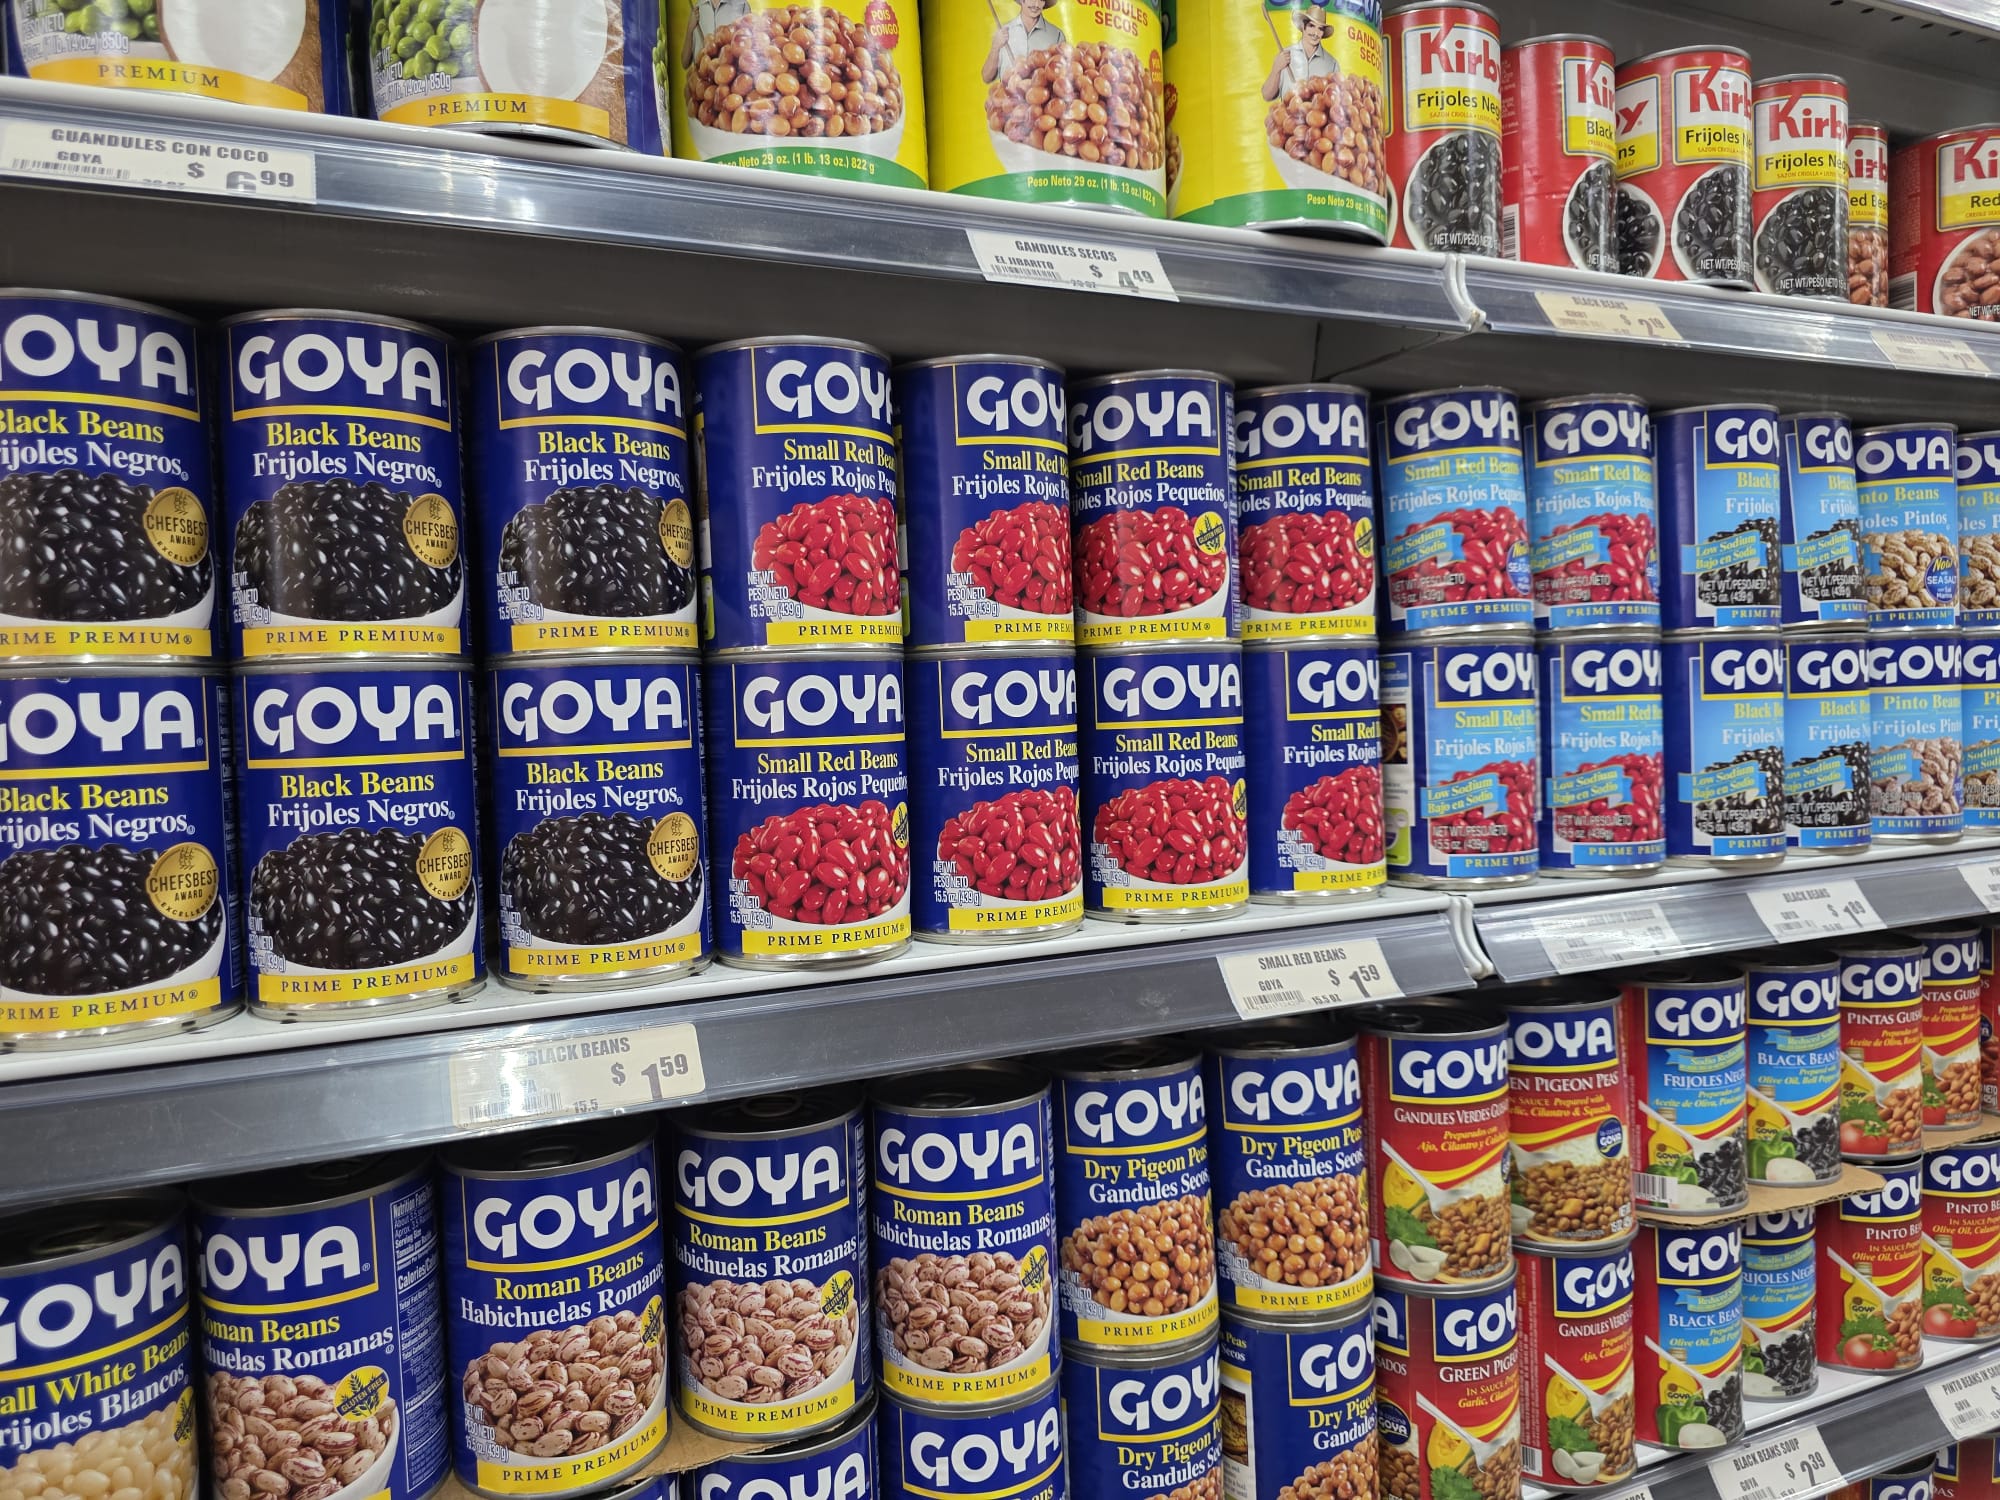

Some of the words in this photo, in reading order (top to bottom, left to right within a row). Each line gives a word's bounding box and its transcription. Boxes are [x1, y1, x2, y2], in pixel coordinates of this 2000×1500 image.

[871, 9, 891, 22] POIS
[1095, 11, 1138, 36] SECOS
[870, 23, 898, 36] CONGO
[98, 64, 220, 89] PREMIUM
[428, 100, 528, 117] PREMIUM
[1417, 90, 1477, 110] Frijoles
[50, 129, 167, 153] GUANDULES
[172, 142, 212, 157] CON
[217, 147, 270, 163] COCO
[1685, 128, 1739, 145] Frijoles
[57, 151, 102, 165] GOYA
[739, 155, 759, 169] Neto
[762, 153, 774, 166] 29
[776, 153, 790, 166] oz.
[792, 152, 801, 166] (1
[804, 152, 816, 166] lb.
[820, 154, 831, 166] 13
[833, 154, 849, 168] oz.)
[851, 159, 867, 171] 822
[869, 162, 875, 174] g
[1765, 155, 1824, 171] Frijoles
[187, 162, 205, 179] $
[1027, 176, 1048, 187] Peso
[1051, 175, 1071, 186] Neto
[1074, 176, 1084, 187] 29
[1087, 178, 1098, 188] oz.
[1110, 179, 1119, 191] lb.
[1122, 183, 1129, 194] 13
[995, 256, 1007, 264] EL
[1009, 257, 1054, 270] JIBARITO
[1015, 240, 1078, 257] GANDULES
[1080, 248, 1117, 262] SECOS
[1089, 264, 1103, 278] $
[239, 334, 442, 407] GOYA
[507, 348, 683, 419] GOYA
[1394, 400, 1519, 449] GOYA
[267, 423, 337, 447] Black
[347, 424, 421, 452] Beans
[538, 431, 605, 454] Black
[613, 434, 670, 460] Beans
[784, 439, 839, 462] Small
[845, 438, 873, 463] Red
[253, 451, 347, 479] Frijoles
[355, 452, 435, 484] Negros
[524, 460, 613, 486] Frijoles
[620, 459, 680, 489] Negros
[752, 466, 826, 492] Frijoles
[831, 465, 876, 490] Rojos
[1117, 463, 1149, 483] Red
[1156, 461, 1204, 481] Beans
[1294, 469, 1322, 487] Red
[1326, 469, 1361, 487] Beans
[1405, 460, 1450, 483] Small
[1105, 488, 1152, 508] Rojos
[1157, 484, 1225, 504] Pequeños
[1390, 491, 1442, 512] Frijoles
[1447, 487, 1488, 507] Rojos
[1894, 487, 1939, 502] Beans
[1904, 511, 1947, 528] Pintos
[1103, 663, 1242, 718] GOYA
[503, 677, 683, 743] GOYA
[743, 673, 901, 734] GOYA
[1884, 695, 1928, 711] Pinto
[253, 684, 455, 753] GOYA
[1873, 718, 1936, 737] Frijoles
[1116, 733, 1166, 753] Small
[1170, 731, 1202, 751] Red
[1205, 730, 1238, 751] Beans
[1435, 738, 1491, 759] Frijoles
[527, 763, 589, 785] Black
[597, 760, 663, 782] Beans
[757, 753, 812, 775] Small
[818, 750, 856, 772] Red
[860, 749, 898, 770] Beans
[1093, 756, 1151, 779] Frijoles
[1154, 753, 1203, 775] Rojos
[79, 783, 168, 810] Beans
[280, 774, 352, 798] Black
[360, 772, 434, 795] Beans
[732, 776, 798, 805] Frijoles
[802, 775, 857, 798] Rojos
[1428, 786, 1449, 801] Low
[1451, 777, 1493, 795] Sodium
[516, 787, 597, 816] Frijoles
[603, 784, 678, 809] Negros
[1427, 800, 1450, 814] Bajo
[1452, 799, 1468, 809] en
[1470, 791, 1493, 806] Sodio
[88, 814, 188, 840] Negros
[268, 801, 359, 831] Frijoles
[367, 799, 449, 825] Negros
[1782, 892, 1807, 902] BLACK
[1258, 955, 1293, 970] SMALL
[1293, 952, 1313, 965] RED
[1314, 948, 1346, 962] BEANS
[1259, 979, 1283, 991] GOYA
[1328, 968, 1340, 986] $
[1847, 1011, 1894, 1026] PINTAS
[527, 1043, 580, 1067] BLACK
[583, 1036, 631, 1058] BEANS
[1757, 1052, 1805, 1066] BLACK
[612, 1062, 625, 1086] $
[1535, 1076, 1594, 1092] PIGEON
[1663, 1070, 1722, 1088] FRIJOLES
[1231, 1059, 1360, 1122] GOYA
[573, 1098, 598, 1114] 15.5
[1394, 1108, 1455, 1126] GANDULES
[879, 1122, 1035, 1184] GOYA
[1241, 1135, 1276, 1158] Dry
[1283, 1130, 1341, 1157] Pigeon
[1084, 1159, 1119, 1182] Dry
[1127, 1155, 1186, 1182] Pigeon
[1246, 1157, 1332, 1180] Gandules
[1089, 1178, 1178, 1204] Gandules
[473, 1167, 652, 1259] GOYA
[893, 1203, 961, 1226] Roman
[968, 1199, 1025, 1227] Beans
[1946, 1201, 1988, 1214] PINTO
[1866, 1227, 1907, 1240] PINTO
[495, 1274, 581, 1301] Roman
[588, 1250, 644, 1285] Beans
[461, 1297, 592, 1329] Habichuelas
[1669, 1311, 1715, 1328] BLACK
[1558, 1316, 1609, 1337] GANDULES
[273, 1326, 393, 1372] Romanas
[1669, 1338, 1695, 1347] Olive
[1696, 1337, 1711, 1347] Oil,
[45, 1365, 136, 1401] White
[1439, 1364, 1490, 1383] GREEN
[1942, 1380, 1963, 1395] PINTO
[1960, 1372, 1982, 1388] BEANS
[1980, 1369, 1989, 1380] IN
[101, 1363, 185, 1424] Blancos
[341, 1391, 367, 1412] GLUTEN
[368, 1377, 384, 1392] FREE
[1734, 1456, 1759, 1472] BLACK
[1758, 1444, 1782, 1463] BEANS
[1782, 1438, 1800, 1453] SOUP
[1784, 1463, 1795, 1480] $
[1740, 1480, 1759, 1491] GOYA
